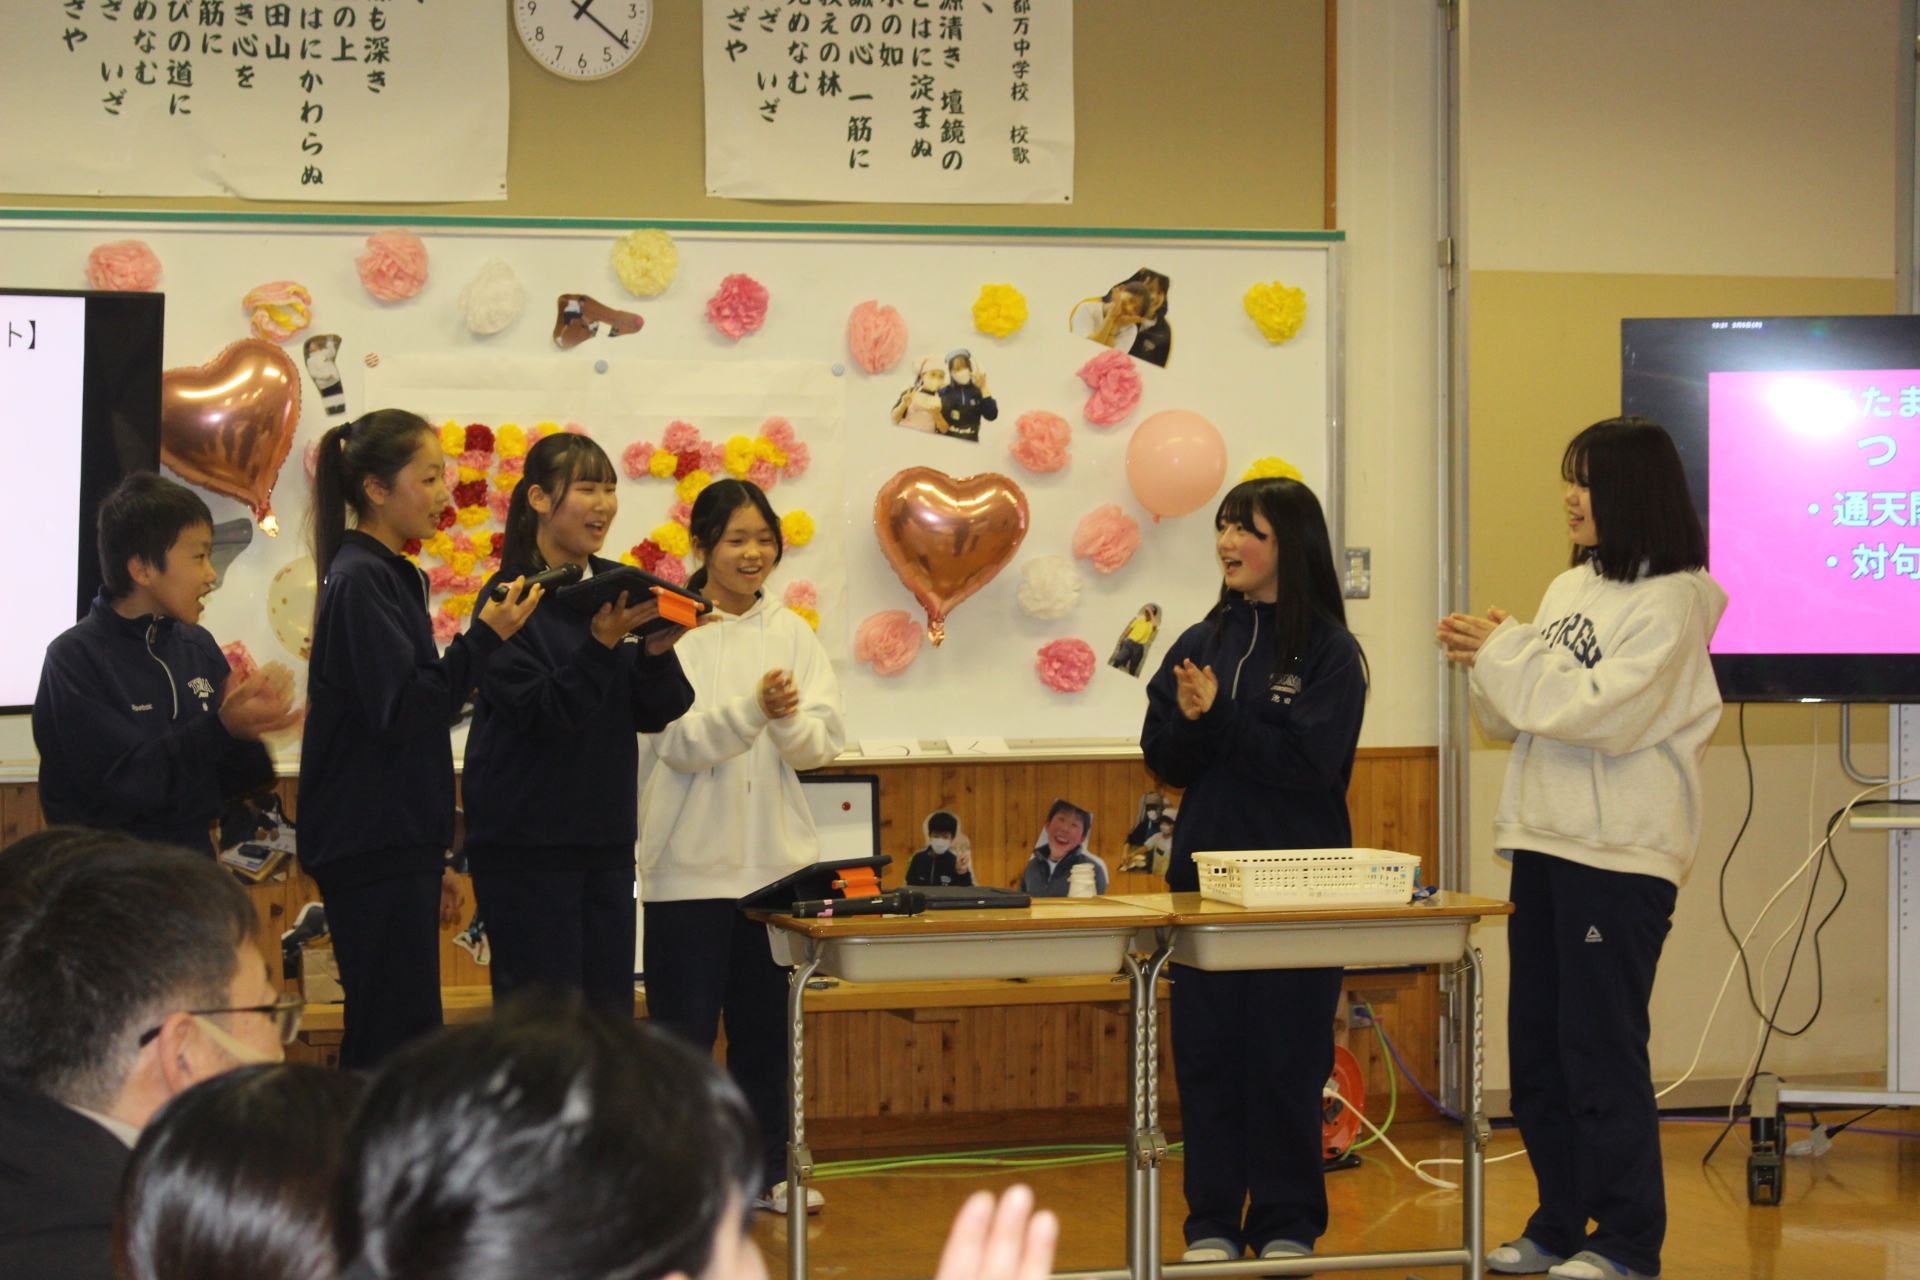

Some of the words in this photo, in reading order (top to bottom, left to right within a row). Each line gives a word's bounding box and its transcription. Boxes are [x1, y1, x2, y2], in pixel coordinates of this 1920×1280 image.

[199, 0, 225, 54] 筋に
[265, 3, 291, 60] 田山
[331, 6, 357, 61] の上
[527, 0, 537, 16] 9
[535, 26, 544, 42] 8
[628, 3, 637, 19] 3
[725, 6, 750, 62] ざや
[133, 0, 157, 85] めなむ
[167, 0, 193, 115] びの道に
[232, 3, 258, 88] き心を
[364, 0, 391, 93] も深き
[555, 45, 564, 61] 7
[577, 53, 587, 69] 6
[602, 47, 612, 62] 5
[619, 29, 630, 45] 4
[786, 0, 811, 95] めなむ
[101, 62, 127, 116] いざ
[299, 6, 323, 186] はにかわらぬ
[1010, 125, 1031, 165] 校歌
[1833, 384, 1920, 419] たま
